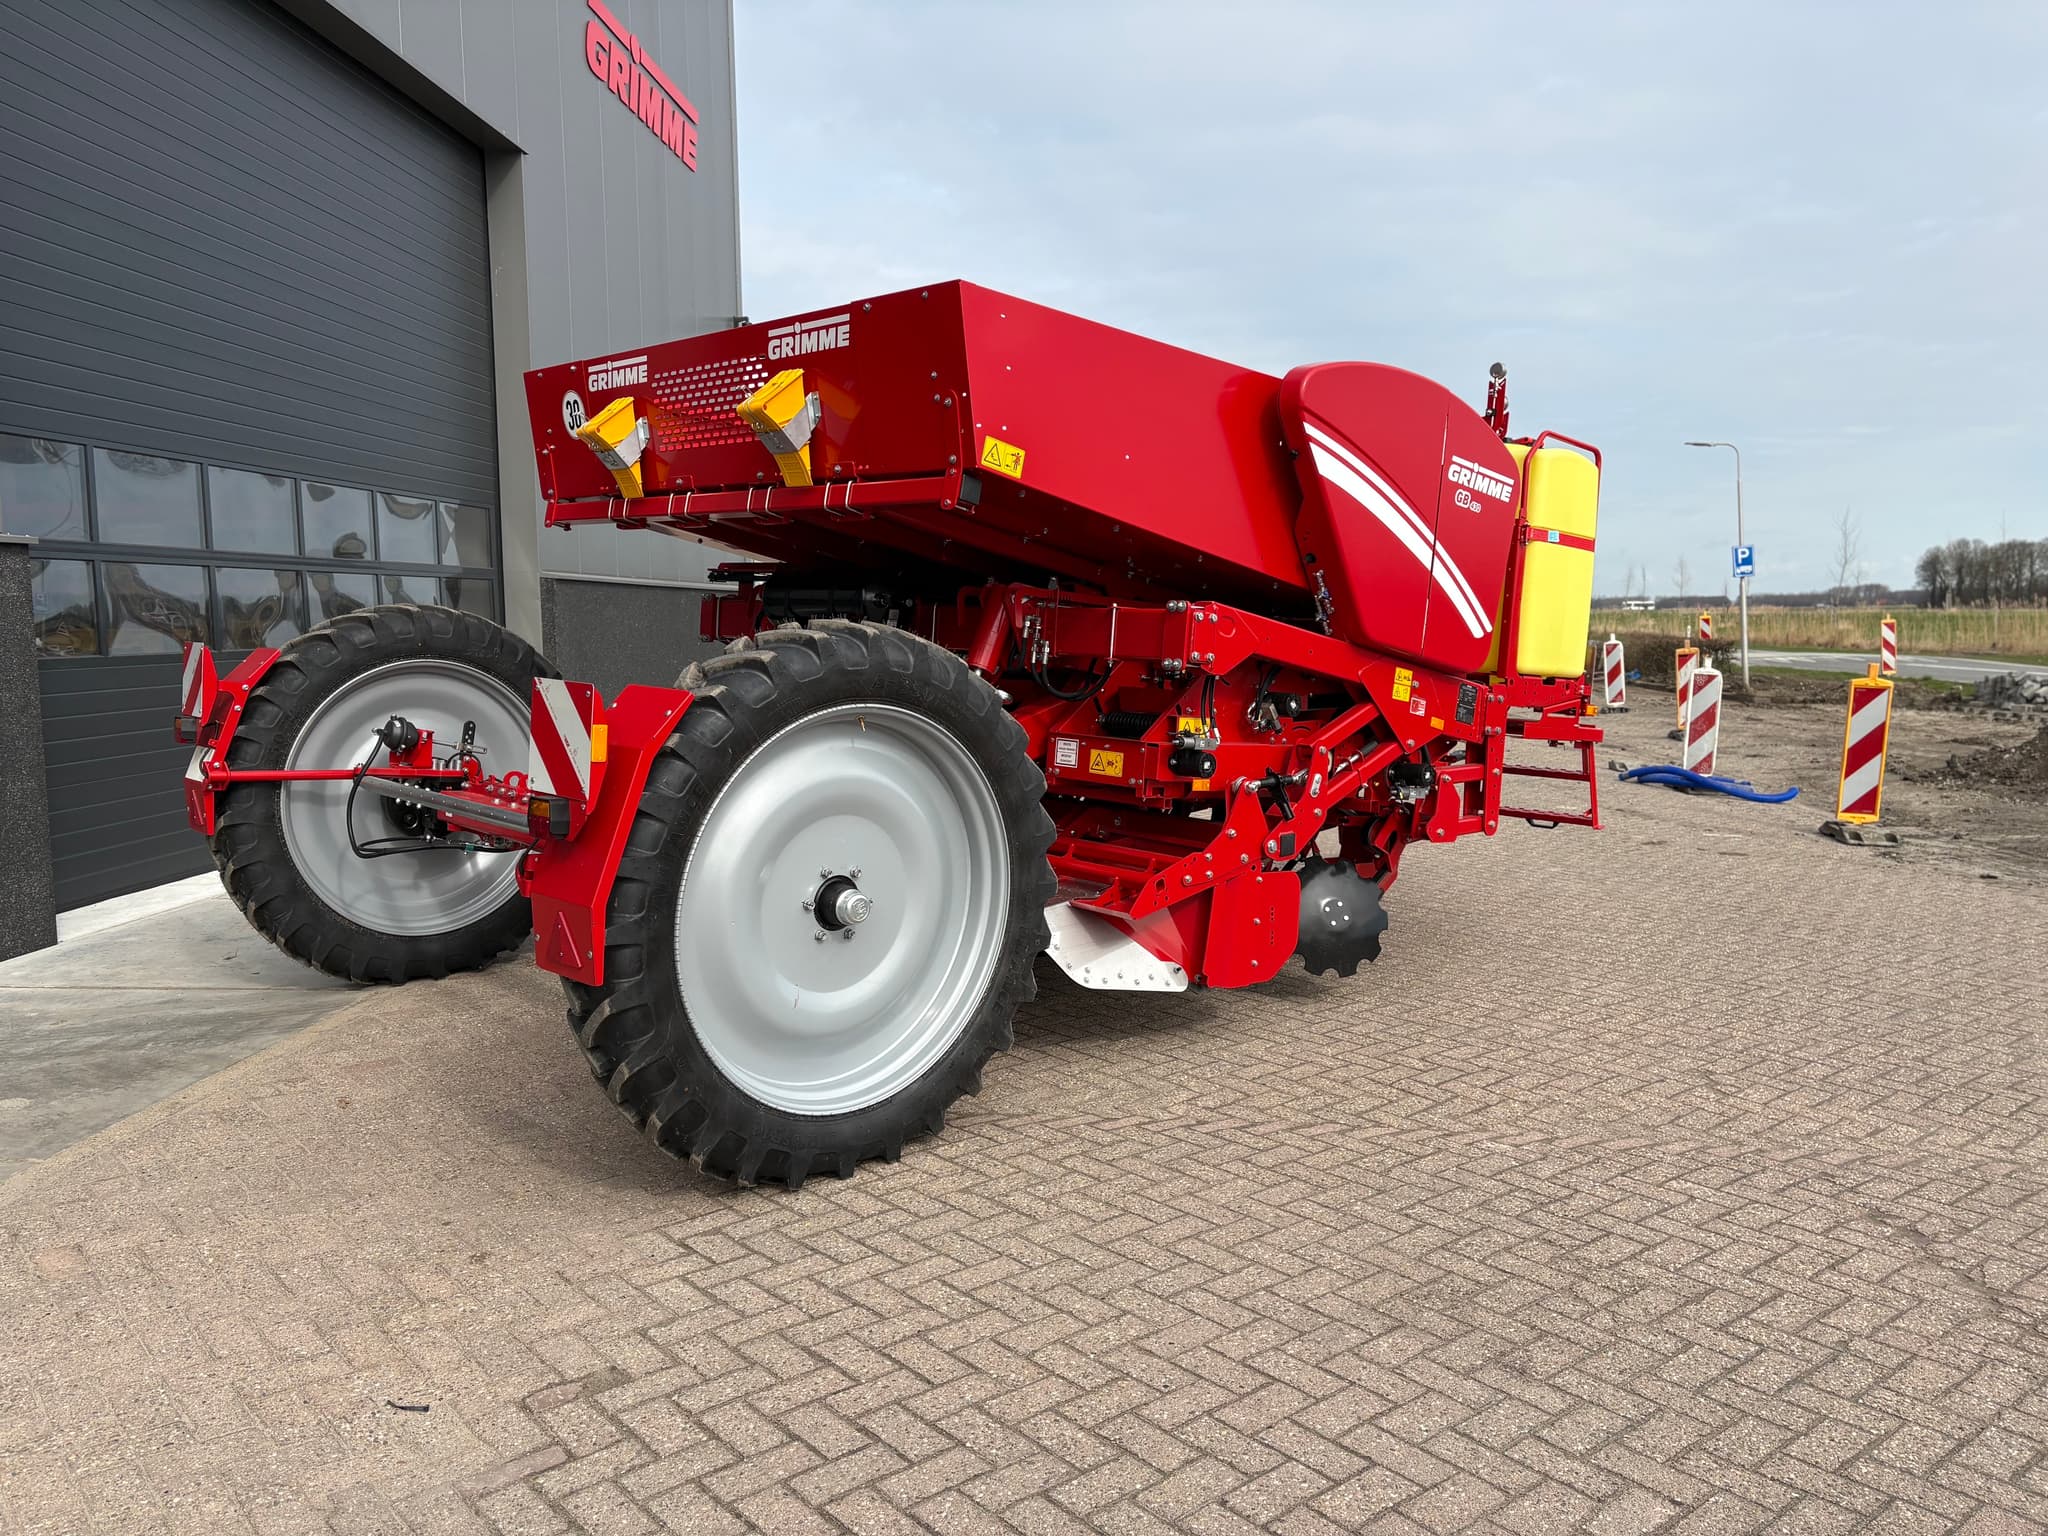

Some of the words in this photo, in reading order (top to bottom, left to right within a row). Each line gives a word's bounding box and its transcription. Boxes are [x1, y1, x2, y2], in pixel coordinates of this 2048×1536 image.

[585, 19, 698, 173] GRIMME
[767, 322, 850, 360] GRIMME
[588, 360, 648, 392] GRIMME
[566, 399, 582, 430] 30
[1448, 463, 1513, 503] GRIMME
[1456, 490, 1470, 506] GB
[1737, 548, 1750, 565] P
